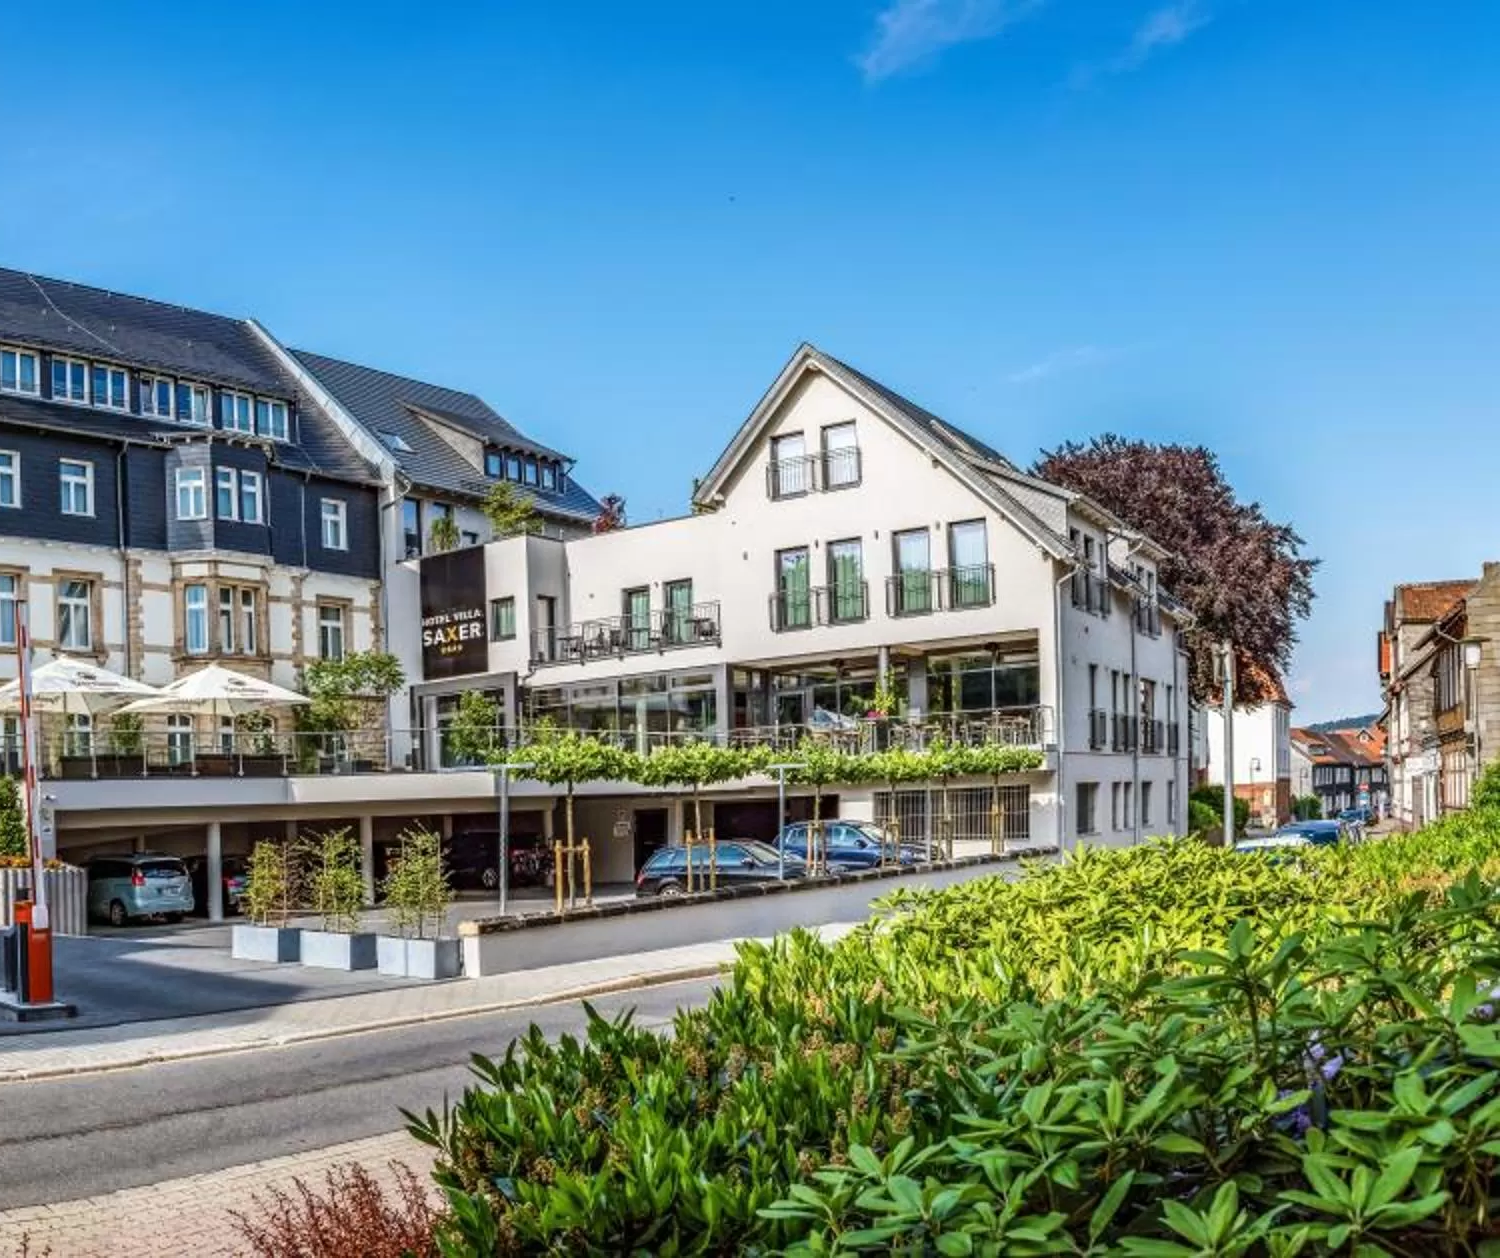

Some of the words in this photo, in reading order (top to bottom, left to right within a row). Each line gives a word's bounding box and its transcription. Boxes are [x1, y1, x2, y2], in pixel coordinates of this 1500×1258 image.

[421, 614, 451, 627] HOTEL
[452, 608, 481, 621] VILLA
[423, 622, 481, 647] SAXER
